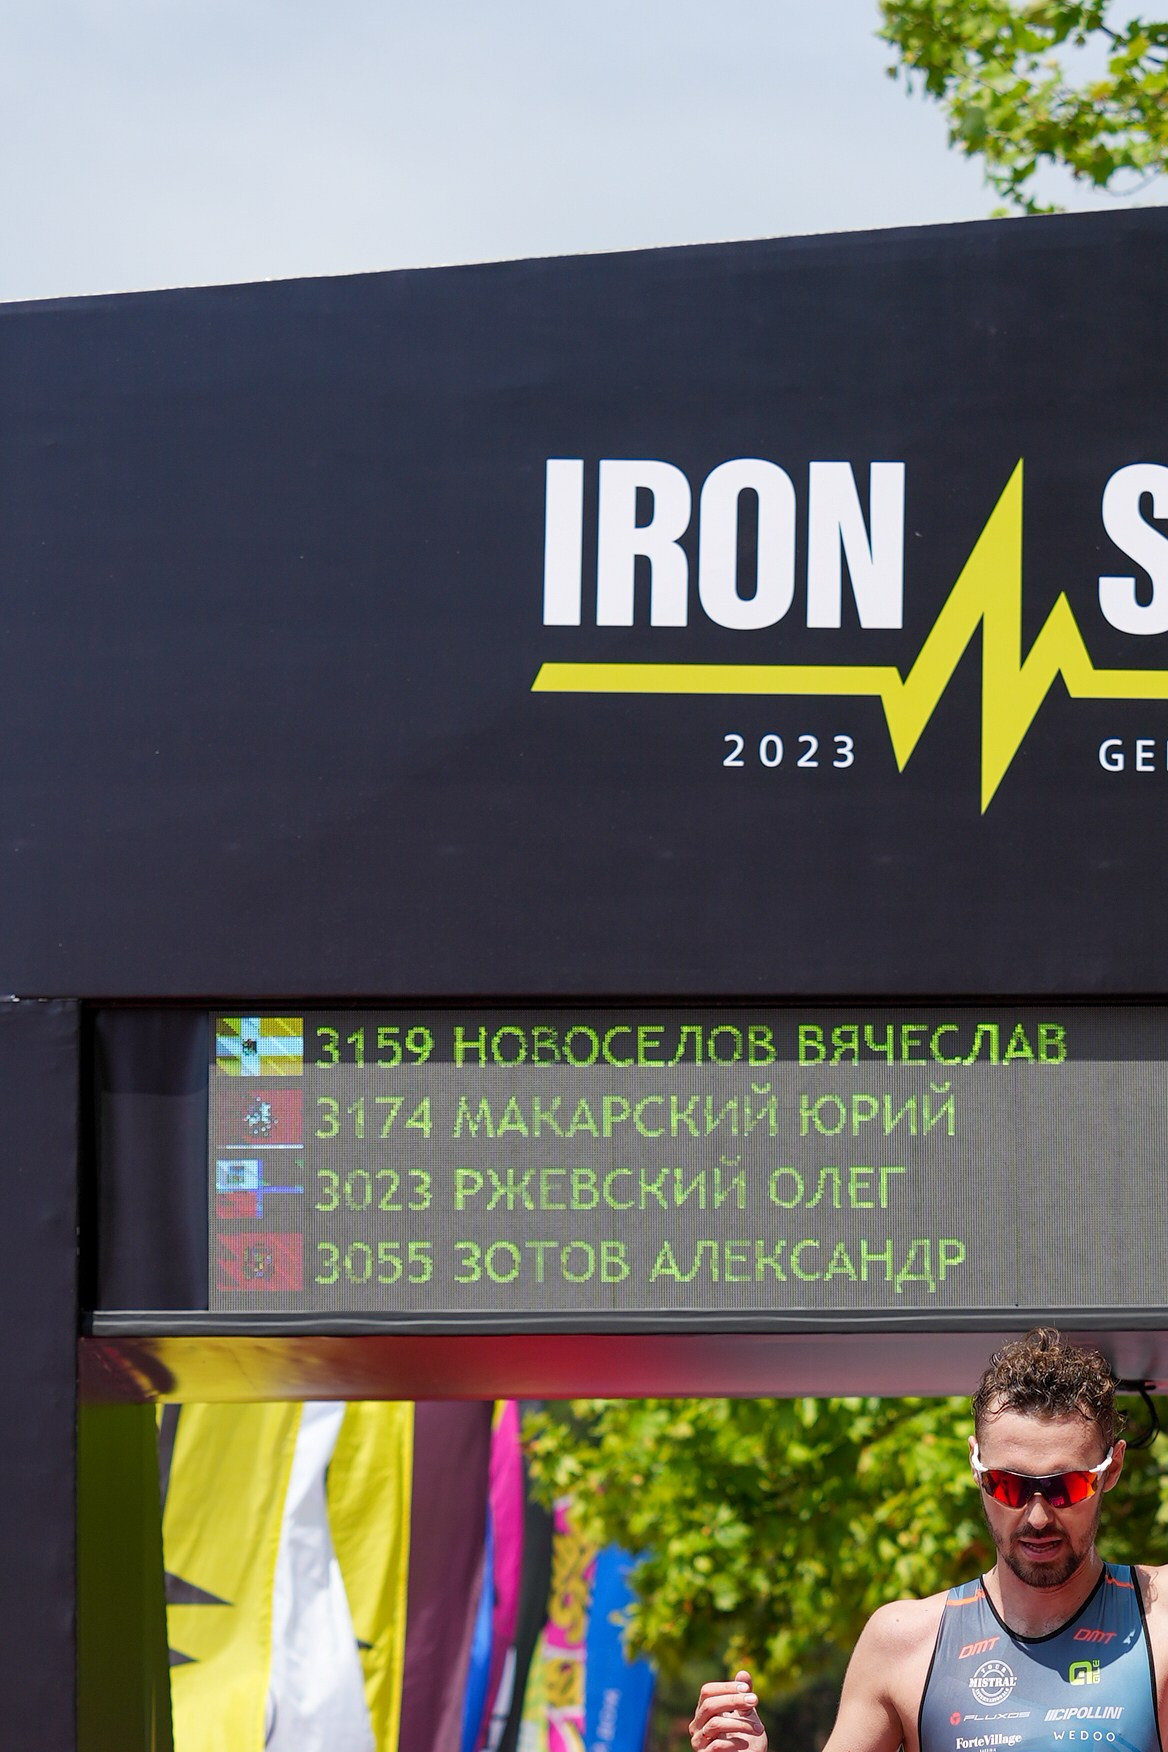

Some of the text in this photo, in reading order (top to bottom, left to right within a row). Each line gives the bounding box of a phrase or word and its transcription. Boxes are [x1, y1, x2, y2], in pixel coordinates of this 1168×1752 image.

[543, 457, 906, 631] IRON
[722, 732, 857, 769] 2023
[315, 1024, 434, 1068] 3159
[454, 1023, 778, 1068] НОВОСЕЛОВ
[800, 1022, 1067, 1066] ВЯЧЕСЛАВ
[315, 1095, 433, 1138] 3174
[453, 1083, 778, 1138] МАКАРСКИЙ
[800, 1082, 957, 1137] ЮРИЙ
[315, 1168, 433, 1212] 3023
[454, 1155, 749, 1211] РЖЕВСКИЙ
[768, 1166, 907, 1210] ОЛЕГ
[315, 1241, 433, 1285] 3055
[454, 1240, 631, 1284] ЗОТОВ
[650, 1238, 967, 1292] АЛЕКСАНДР
[1073, 1628, 1118, 1645] DMT
[958, 1637, 1001, 1660] DMT
[968, 1676, 1018, 1688] MISTRAL
[963, 1711, 1032, 1723] FLUXOS
[1048, 1706, 1124, 1722] CIPOLLINI
[955, 1733, 1023, 1750] ForteVillage
[1053, 1729, 1116, 1743] WEDOO
